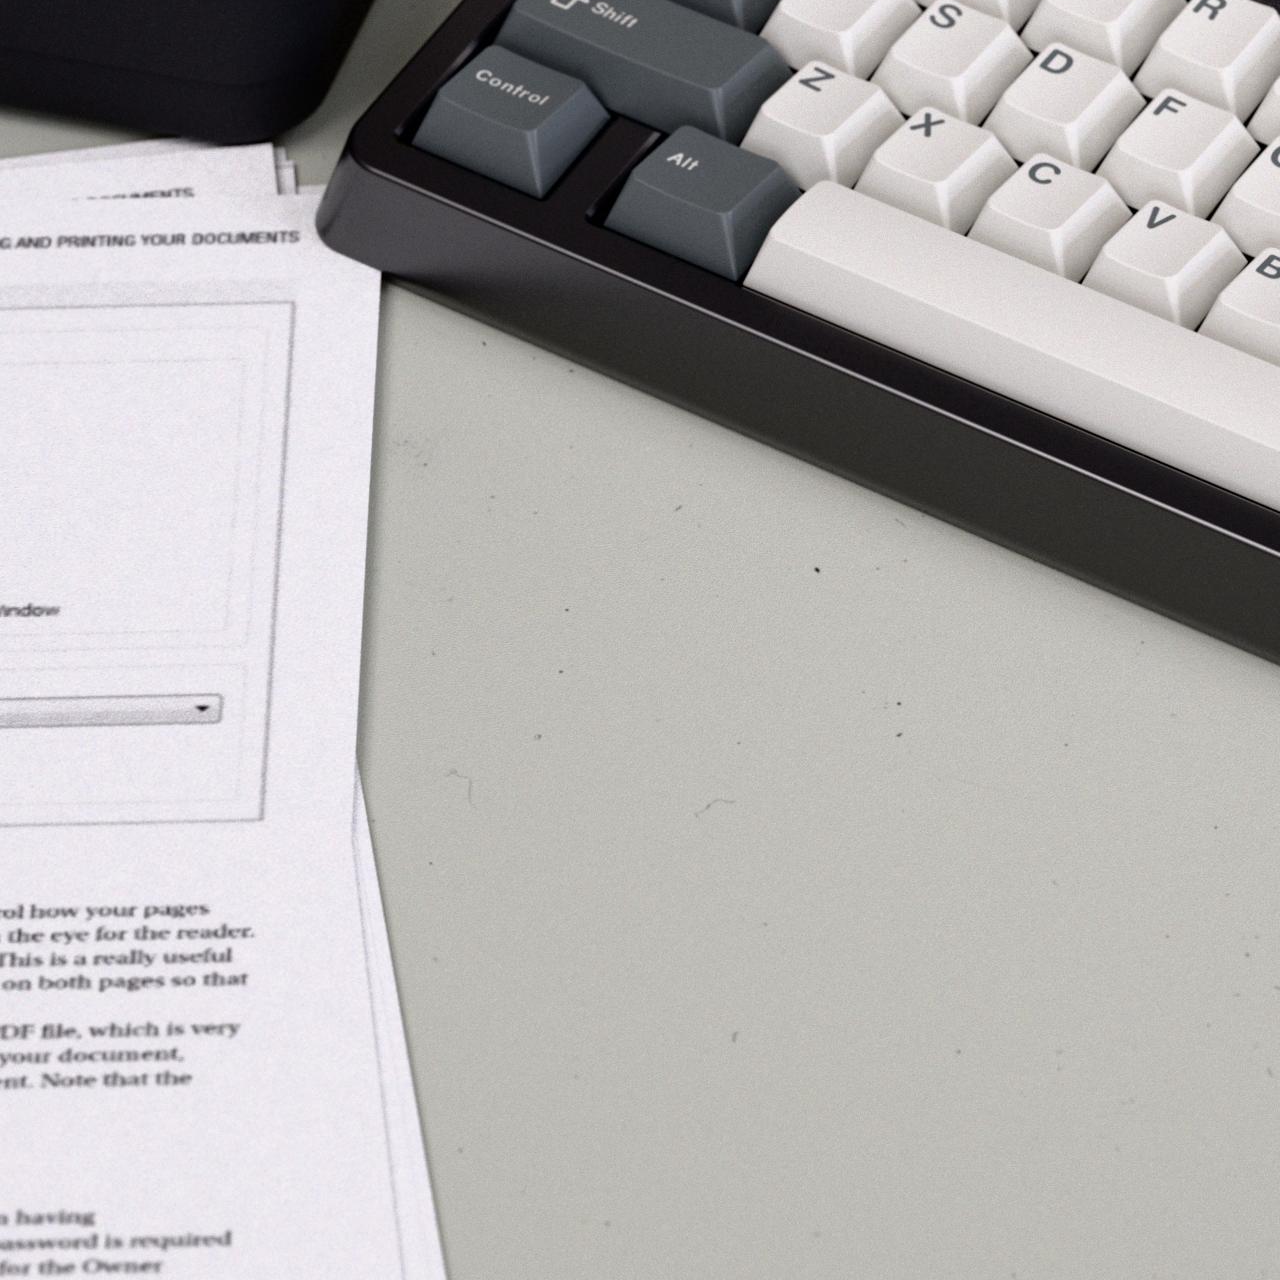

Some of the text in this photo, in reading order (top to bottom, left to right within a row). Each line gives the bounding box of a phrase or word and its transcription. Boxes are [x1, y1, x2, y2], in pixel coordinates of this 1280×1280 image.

[591, 1, 638, 28] Shift
[929, 3, 963, 29] S
[1040, 49, 1074, 74] D
[475, 69, 550, 106] Control
[799, 67, 835, 92] Z
[1153, 96, 1187, 115] F
[910, 113, 945, 137] X
[666, 152, 699, 171] Alt
[1028, 162, 1062, 185] C
[1146, 206, 1177, 230] V
[13, 235, 53, 250] AND
[55, 233, 137, 249] PRINTING
[139, 232, 187, 247] YOUR
[190, 229, 301, 246] DOCUMENTS
[28, 903, 79, 920] how
[85, 905, 138, 922] your
[142, 904, 211, 920] pages
[7, 922, 255, 946] the eye for the reader.
[48, 951, 69, 968] is
[72, 954, 88, 967] a
[92, 948, 157, 968] really
[162, 946, 234, 965] useful
[0, 970, 249, 993] on both pages so that
[87, 1021, 161, 1039] which
[165, 1021, 186, 1037] is
[190, 1022, 241, 1039] very
[0, 1051, 52, 1069] your
[40, 1072, 99, 1089] Note
[101, 1070, 150, 1089] that
[154, 1069, 194, 1087] the
[14, 1208, 96, 1228] having
[103, 1233, 125, 1250] is
[128, 1229, 234, 1253] required
[37, 1258, 77, 1277] the
[80, 1257, 163, 1275] Owner
